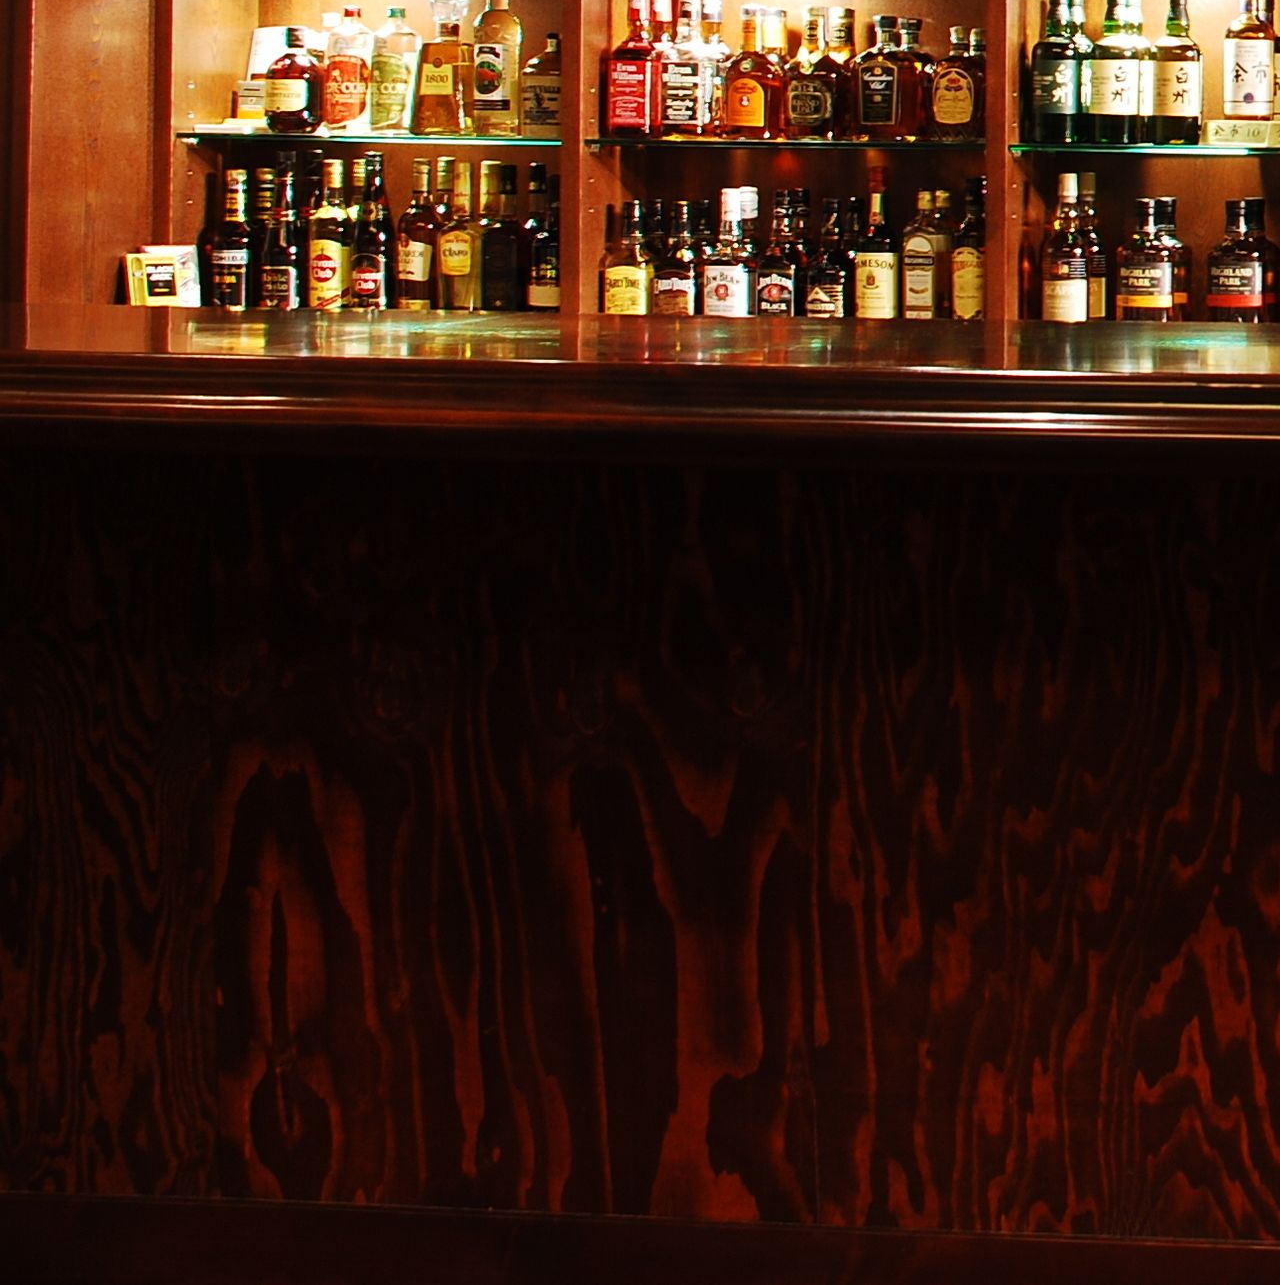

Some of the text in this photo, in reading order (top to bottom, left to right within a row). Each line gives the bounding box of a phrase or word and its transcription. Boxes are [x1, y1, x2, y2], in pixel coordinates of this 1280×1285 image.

[426, 74, 448, 83] 1800
[1119, 267, 1163, 278] HIGHLAND
[1128, 277, 1151, 287] PARK
[1218, 277, 1242, 287] PARK
